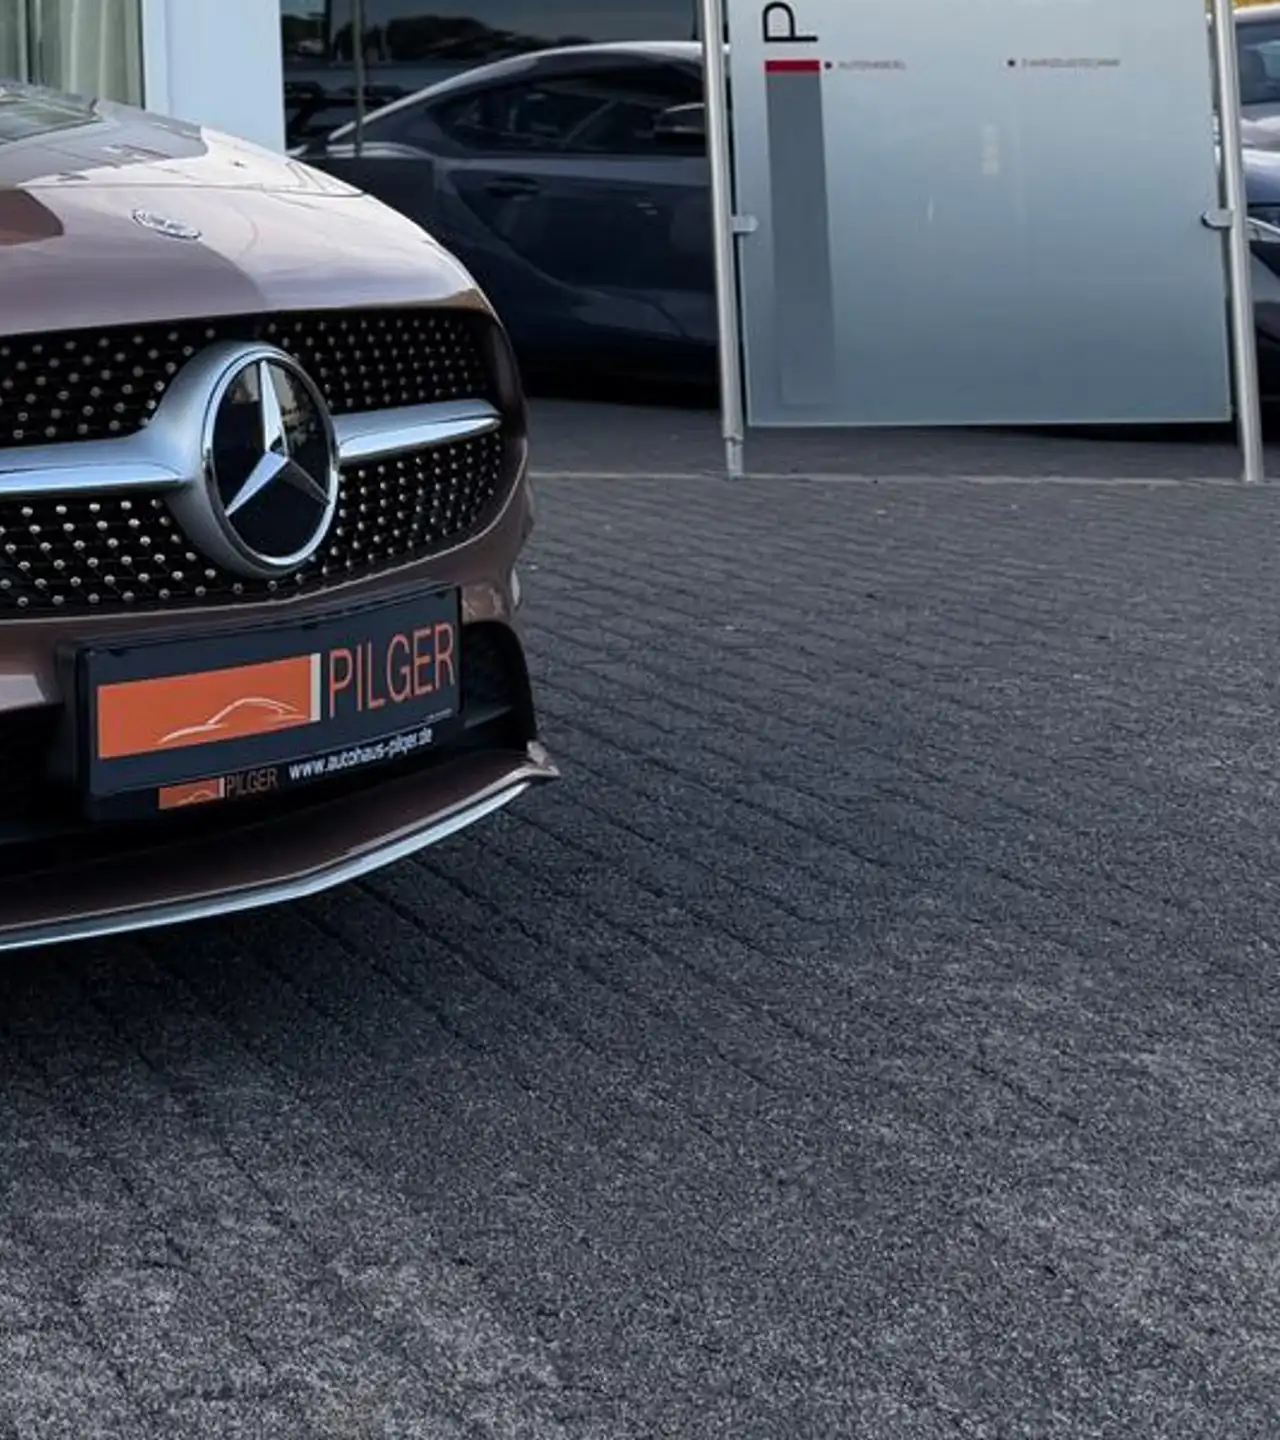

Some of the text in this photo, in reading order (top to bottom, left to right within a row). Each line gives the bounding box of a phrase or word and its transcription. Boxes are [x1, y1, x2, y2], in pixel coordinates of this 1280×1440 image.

[329, 622, 455, 719] PILGER
[289, 727, 433, 780] www.autohaus-pilger.de
[226, 767, 278, 798] PILGER
